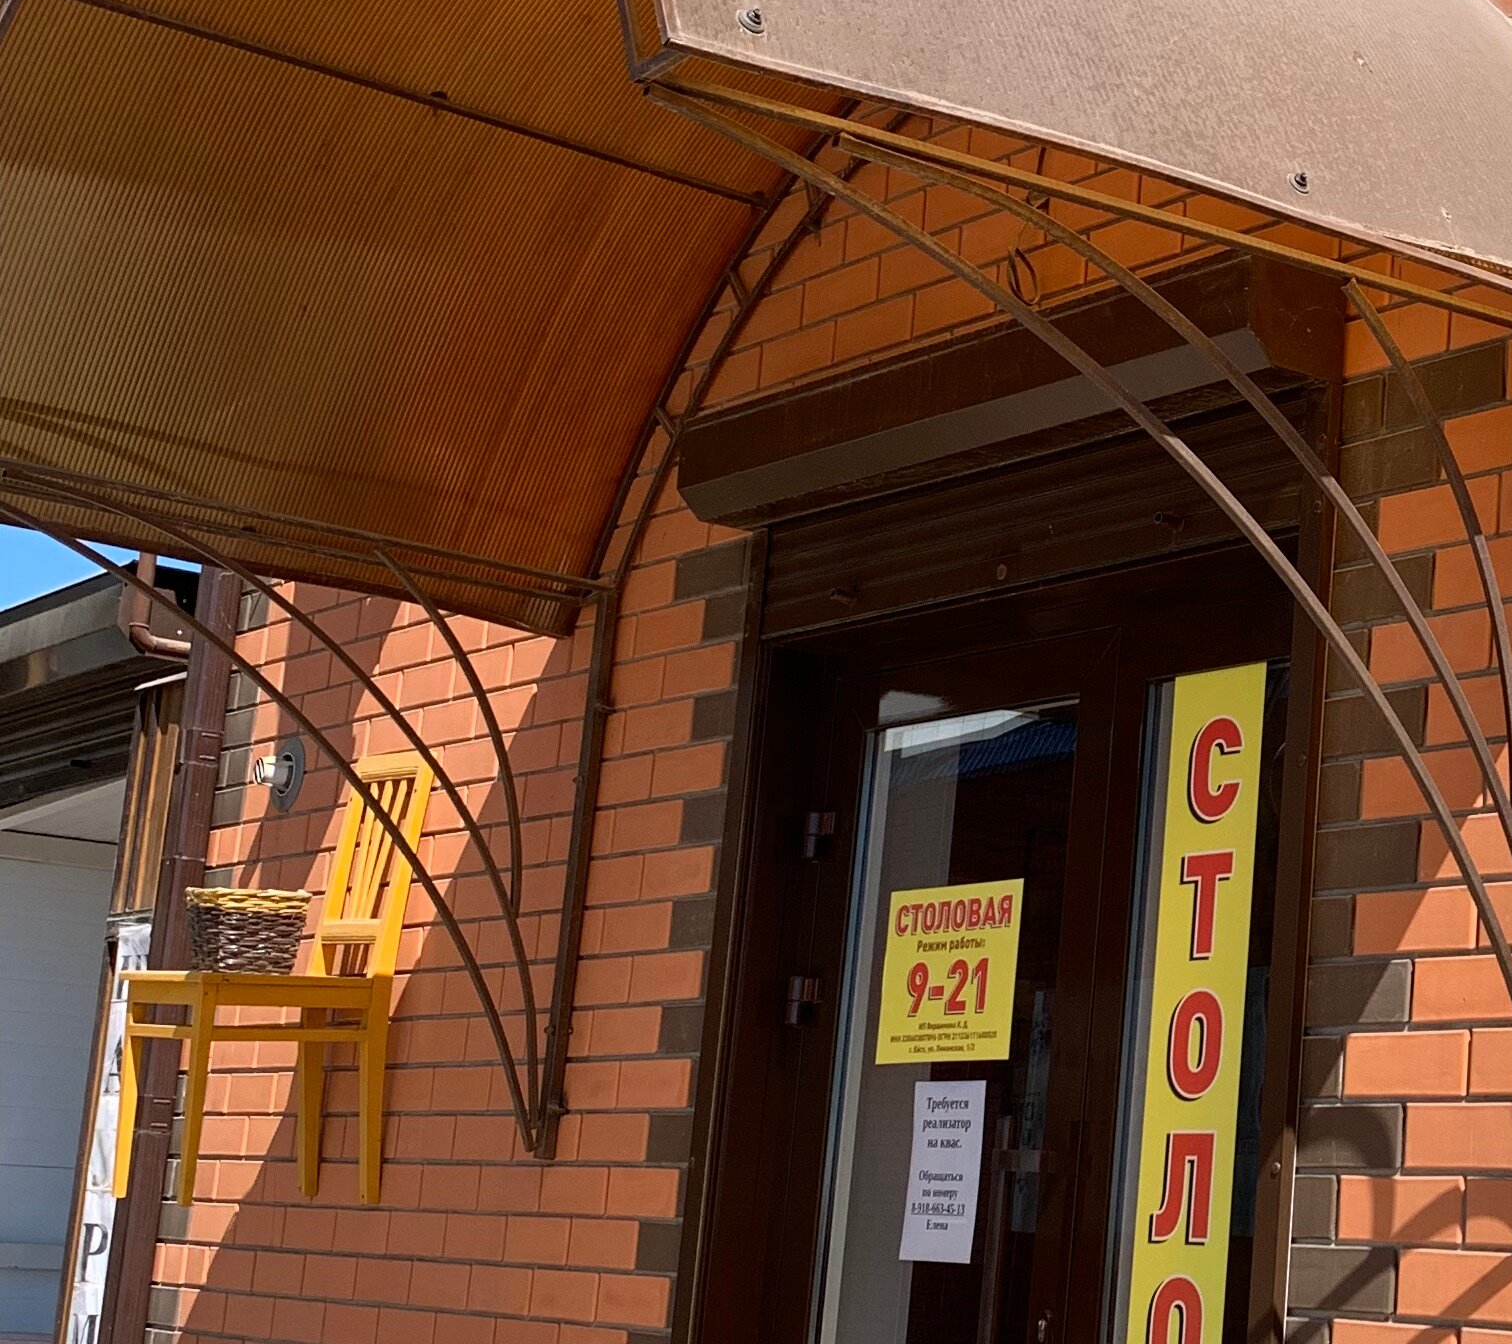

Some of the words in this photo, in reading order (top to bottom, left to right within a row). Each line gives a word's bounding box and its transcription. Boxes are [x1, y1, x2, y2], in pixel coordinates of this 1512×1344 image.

[896, 895, 1013, 936] СТОЛОВАЯ
[917, 939, 947, 952] Режим
[949, 936, 986, 953] работы:
[907, 957, 990, 1017] 9-21
[926, 1097, 969, 1113] Требуется
[922, 1118, 971, 1132] реализатор
[927, 1138, 937, 1148] на
[940, 1137, 962, 1148] квас.
